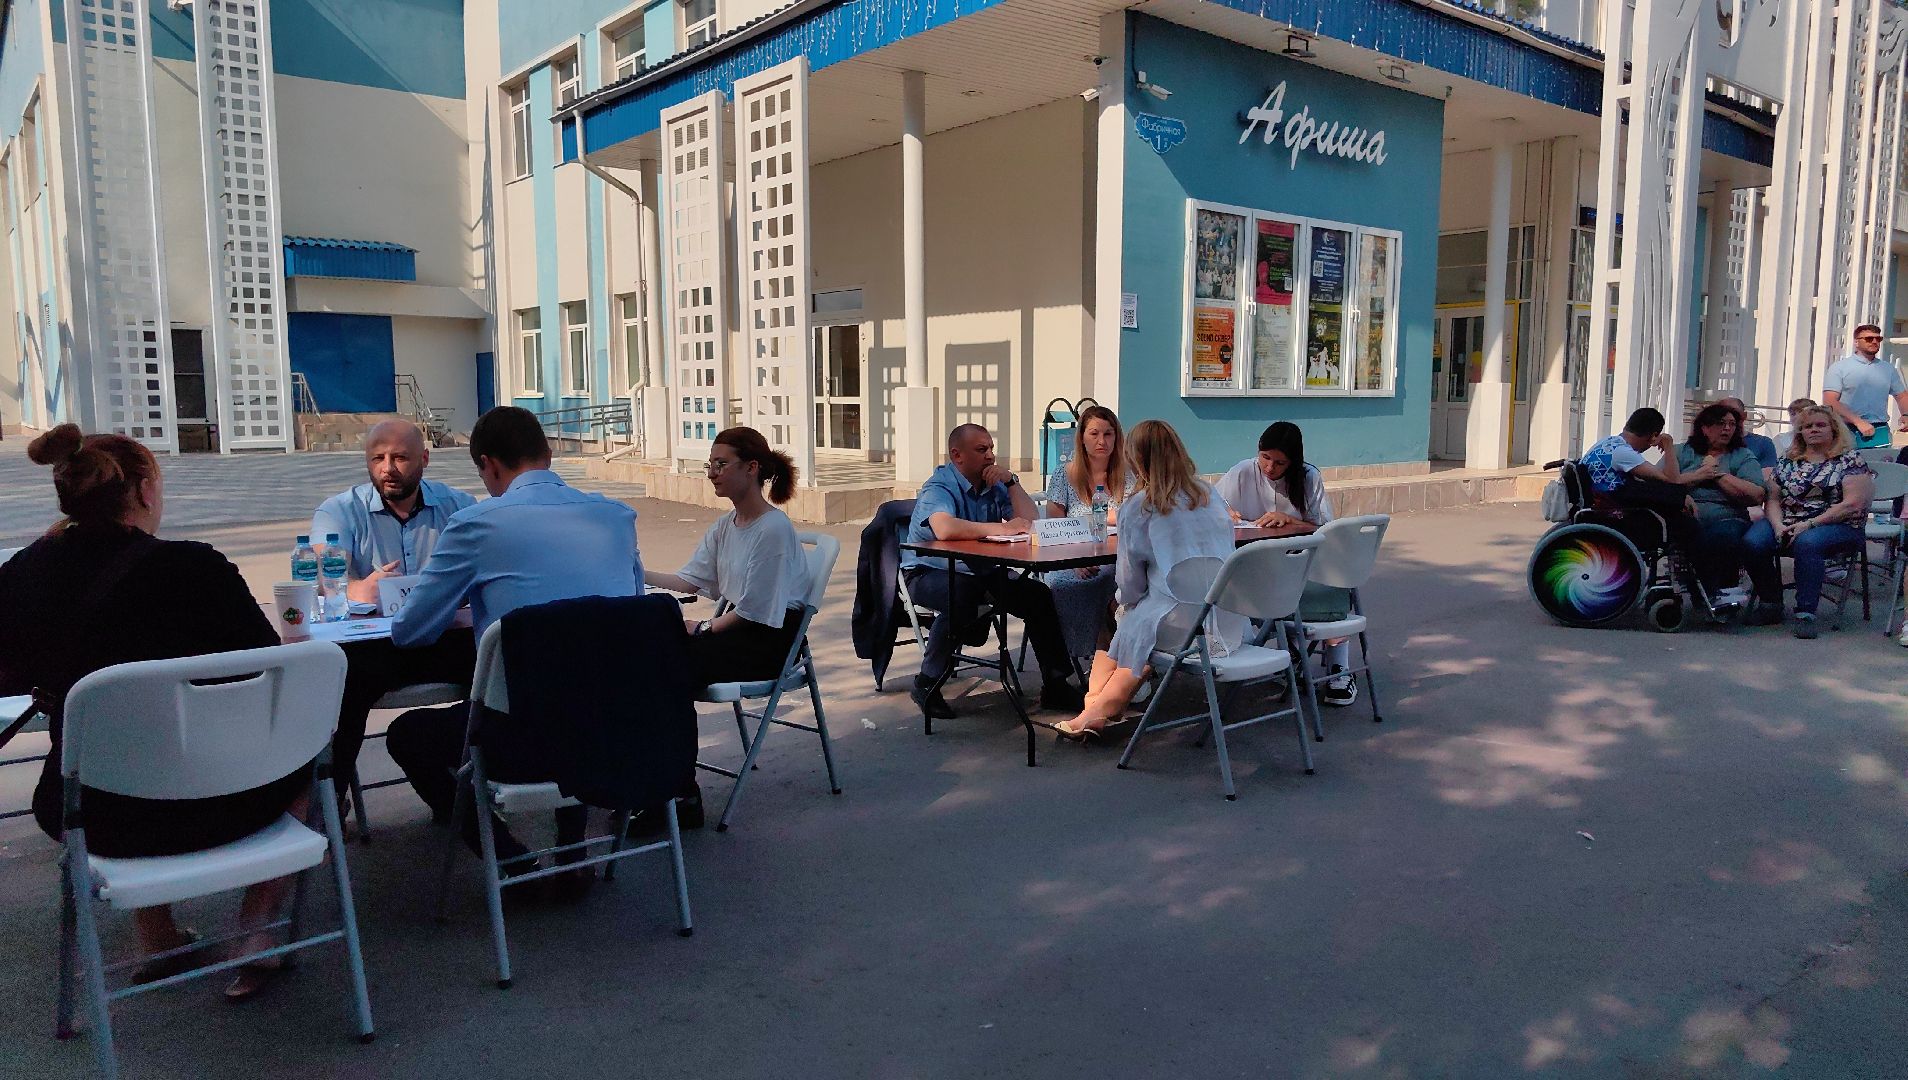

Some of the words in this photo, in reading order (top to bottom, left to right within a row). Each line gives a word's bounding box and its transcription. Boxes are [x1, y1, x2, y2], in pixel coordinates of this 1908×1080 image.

[1141, 117, 1181, 136] Фабричная
[1238, 80, 1388, 170] Афиша
[1156, 135, 1161, 150] 1
